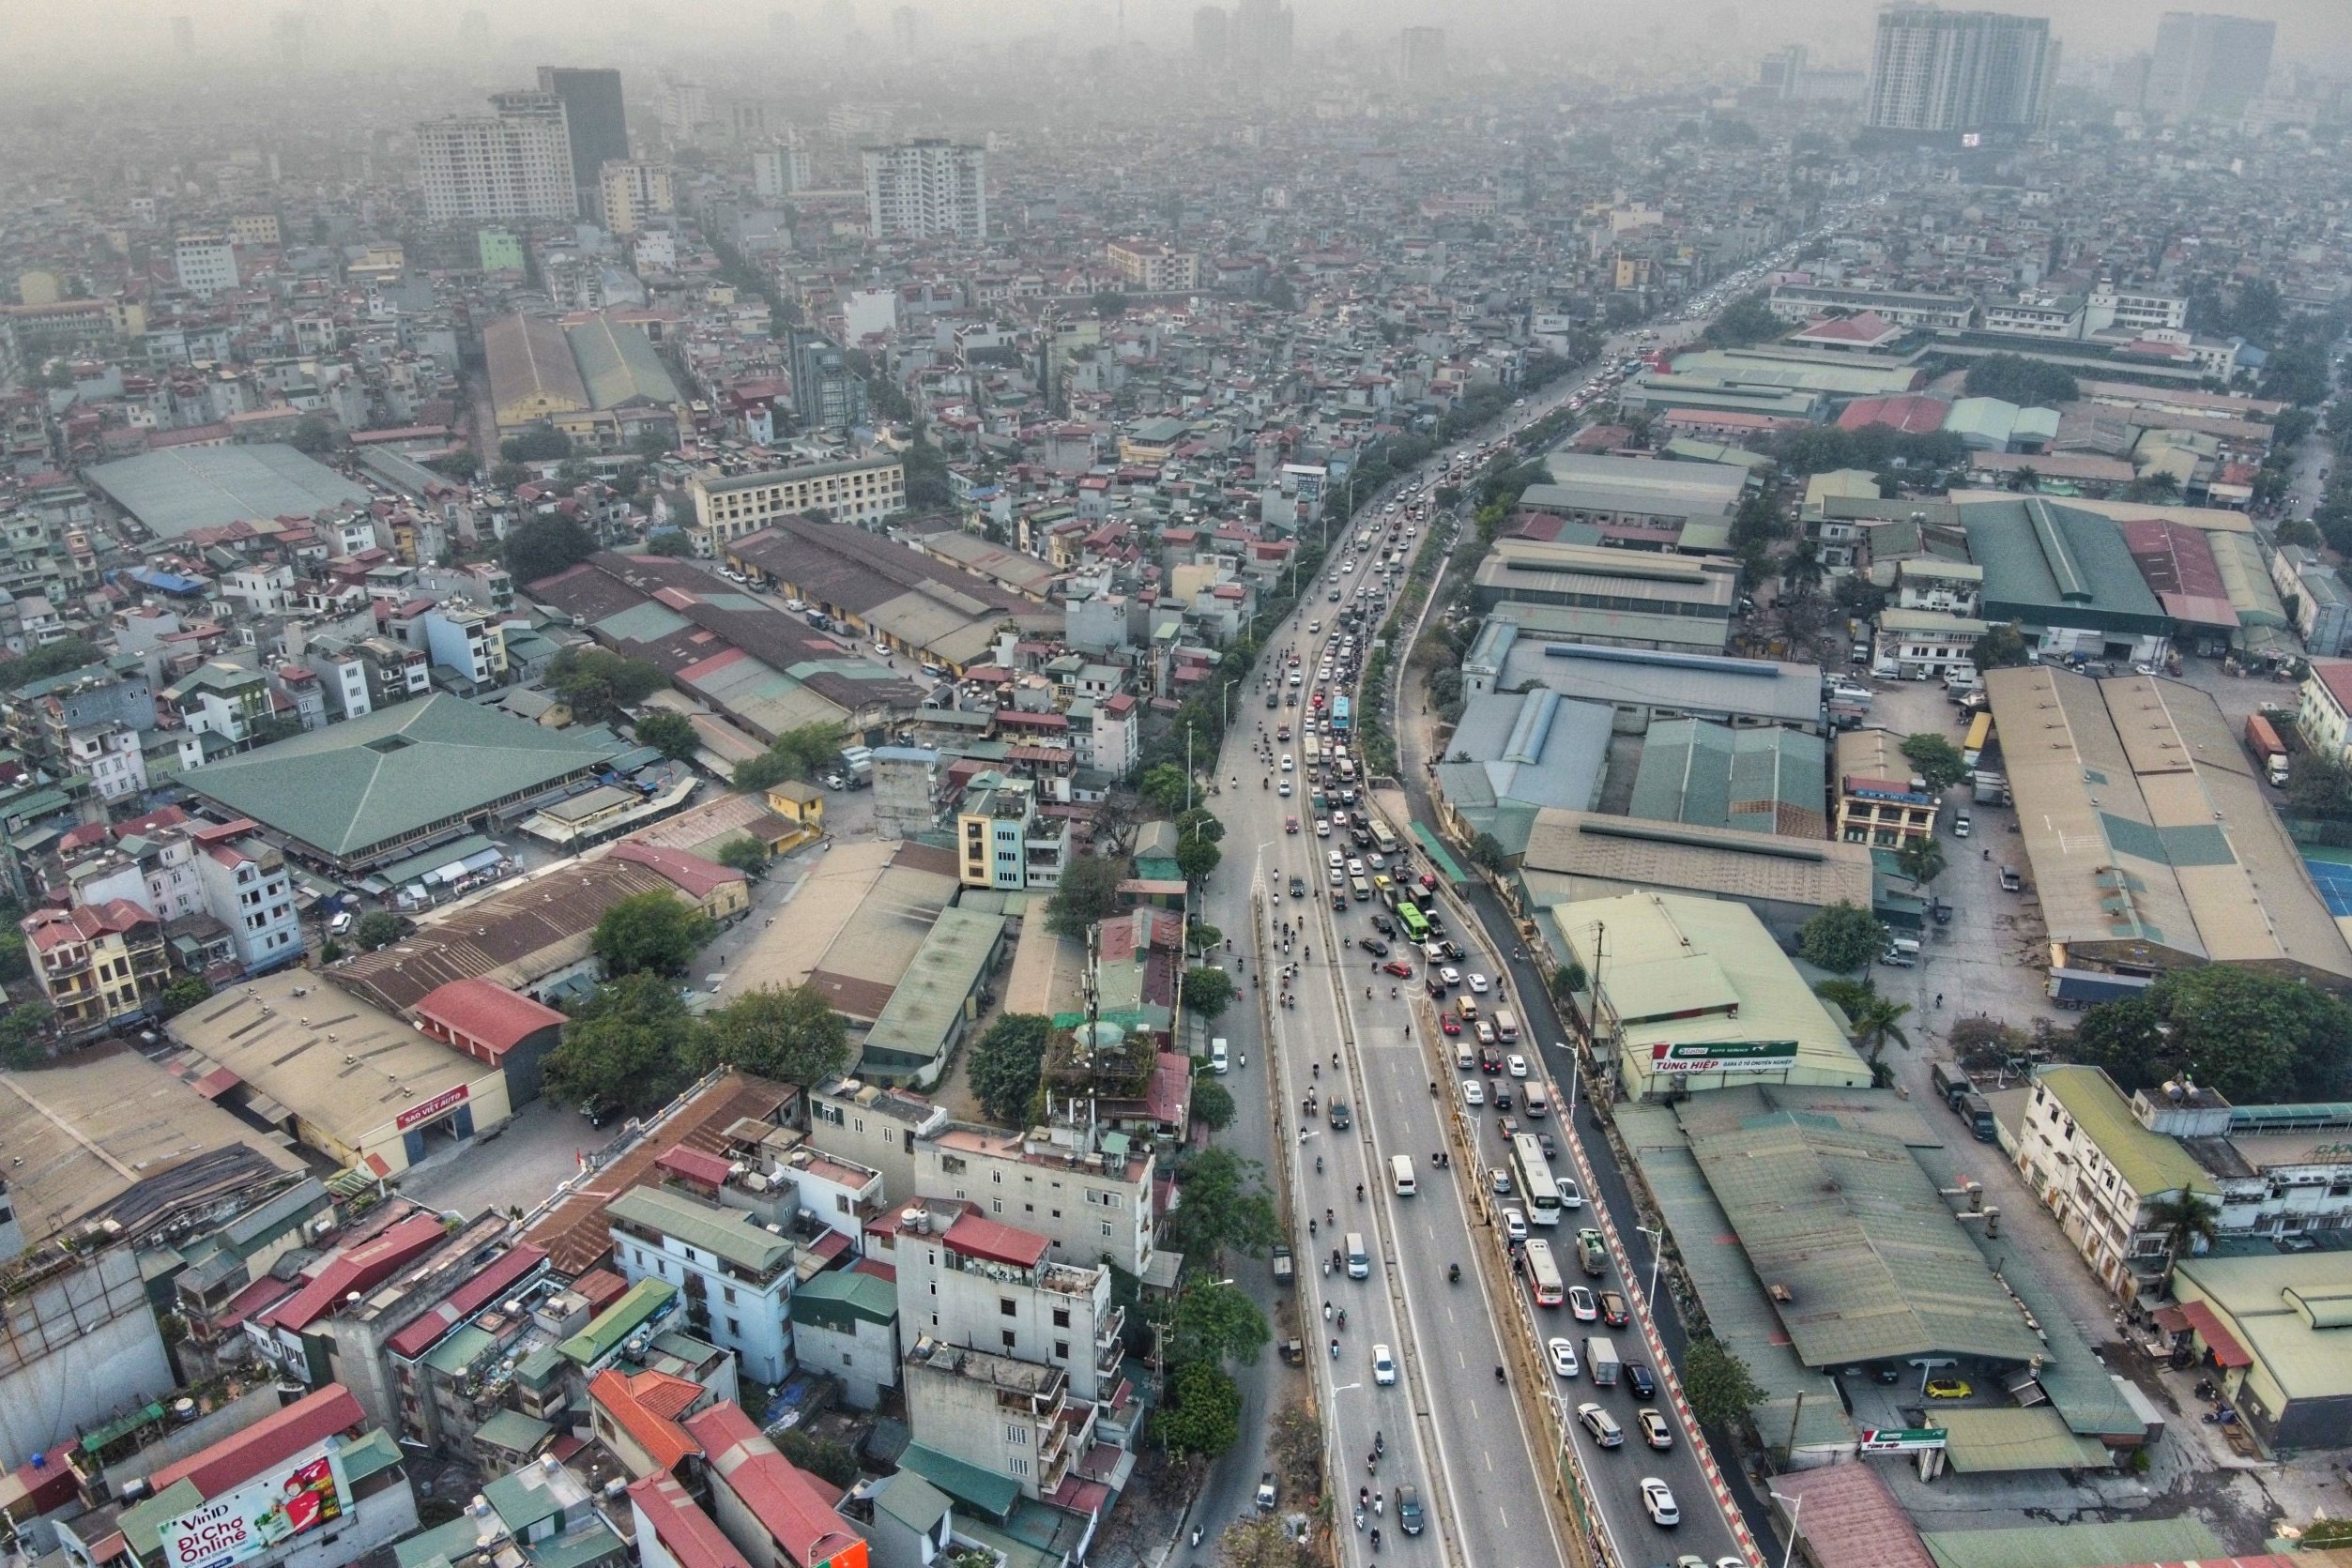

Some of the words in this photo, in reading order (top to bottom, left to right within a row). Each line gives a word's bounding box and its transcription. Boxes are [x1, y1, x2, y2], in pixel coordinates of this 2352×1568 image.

[1657, 1060, 1688, 1070] TÙNG
[1690, 1059, 1719, 1071] HIỆP
[405, 1112, 421, 1123] SAO
[421, 1102, 439, 1116] VIỆT
[440, 1092, 461, 1107] AUTO
[181, 1504, 228, 1530] VinID
[178, 1532, 200, 1551] Đi
[202, 1515, 243, 1540] Chợ
[181, 1530, 247, 1562] Online
